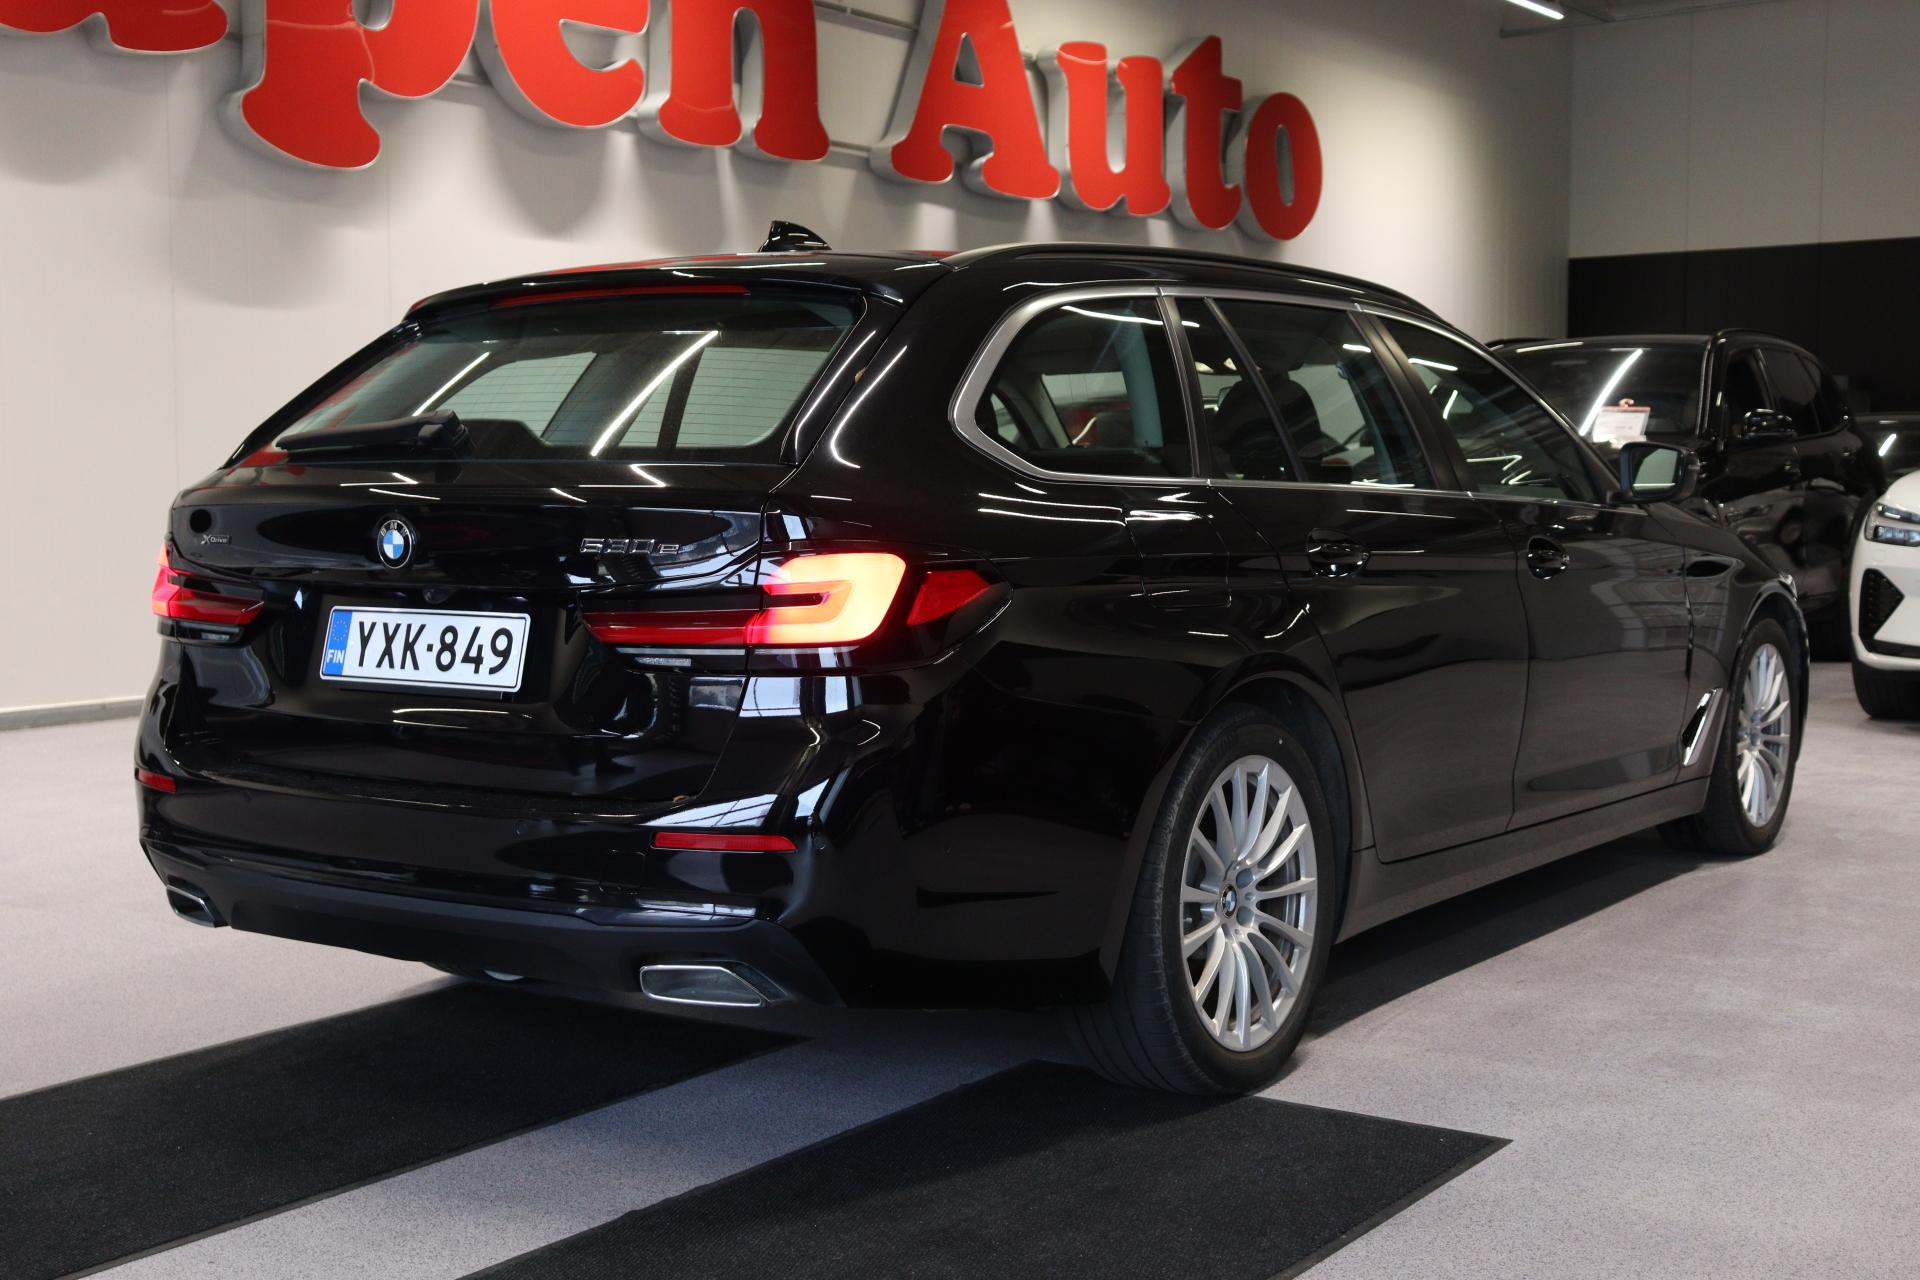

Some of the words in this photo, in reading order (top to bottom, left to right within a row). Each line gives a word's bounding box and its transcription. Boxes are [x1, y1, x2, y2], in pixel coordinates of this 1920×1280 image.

[891, 0, 1323, 241] Auto
[380, 521, 408, 537] BMW
[326, 649, 345, 664] FIN
